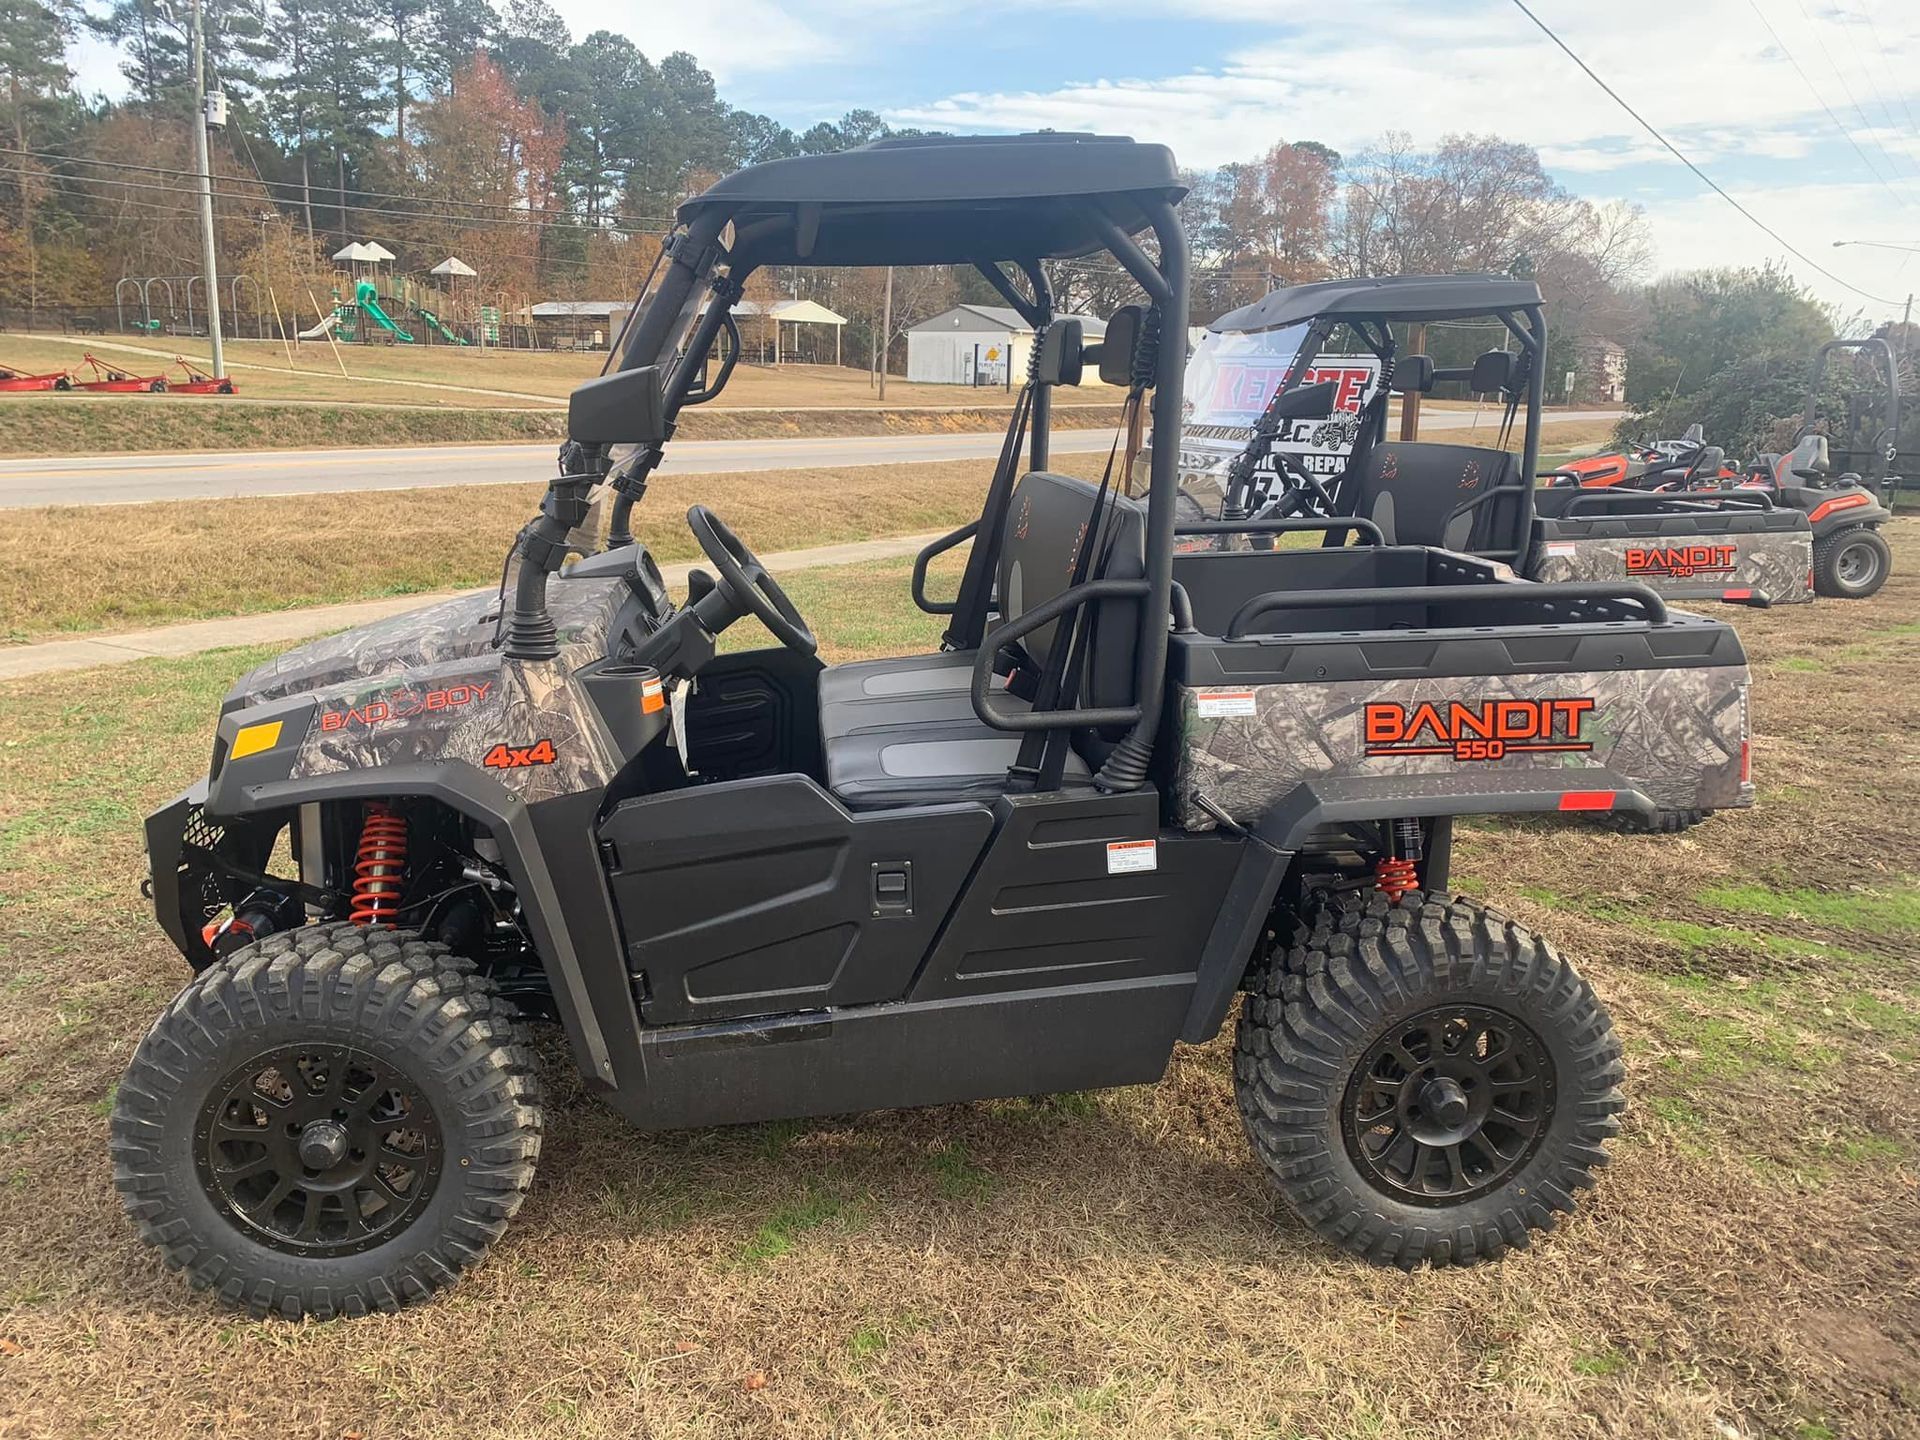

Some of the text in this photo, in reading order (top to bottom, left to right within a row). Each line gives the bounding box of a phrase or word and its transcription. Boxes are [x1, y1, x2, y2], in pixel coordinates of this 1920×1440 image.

[1303, 454, 1350, 473] REPA
[1626, 545, 1736, 568] BANDIT
[1669, 566, 1693, 577] 750
[321, 681, 491, 732] BAD BOY
[1365, 701, 1594, 742] BANDIT
[484, 739, 556, 769] 4x4
[1456, 739, 1504, 760] 550
